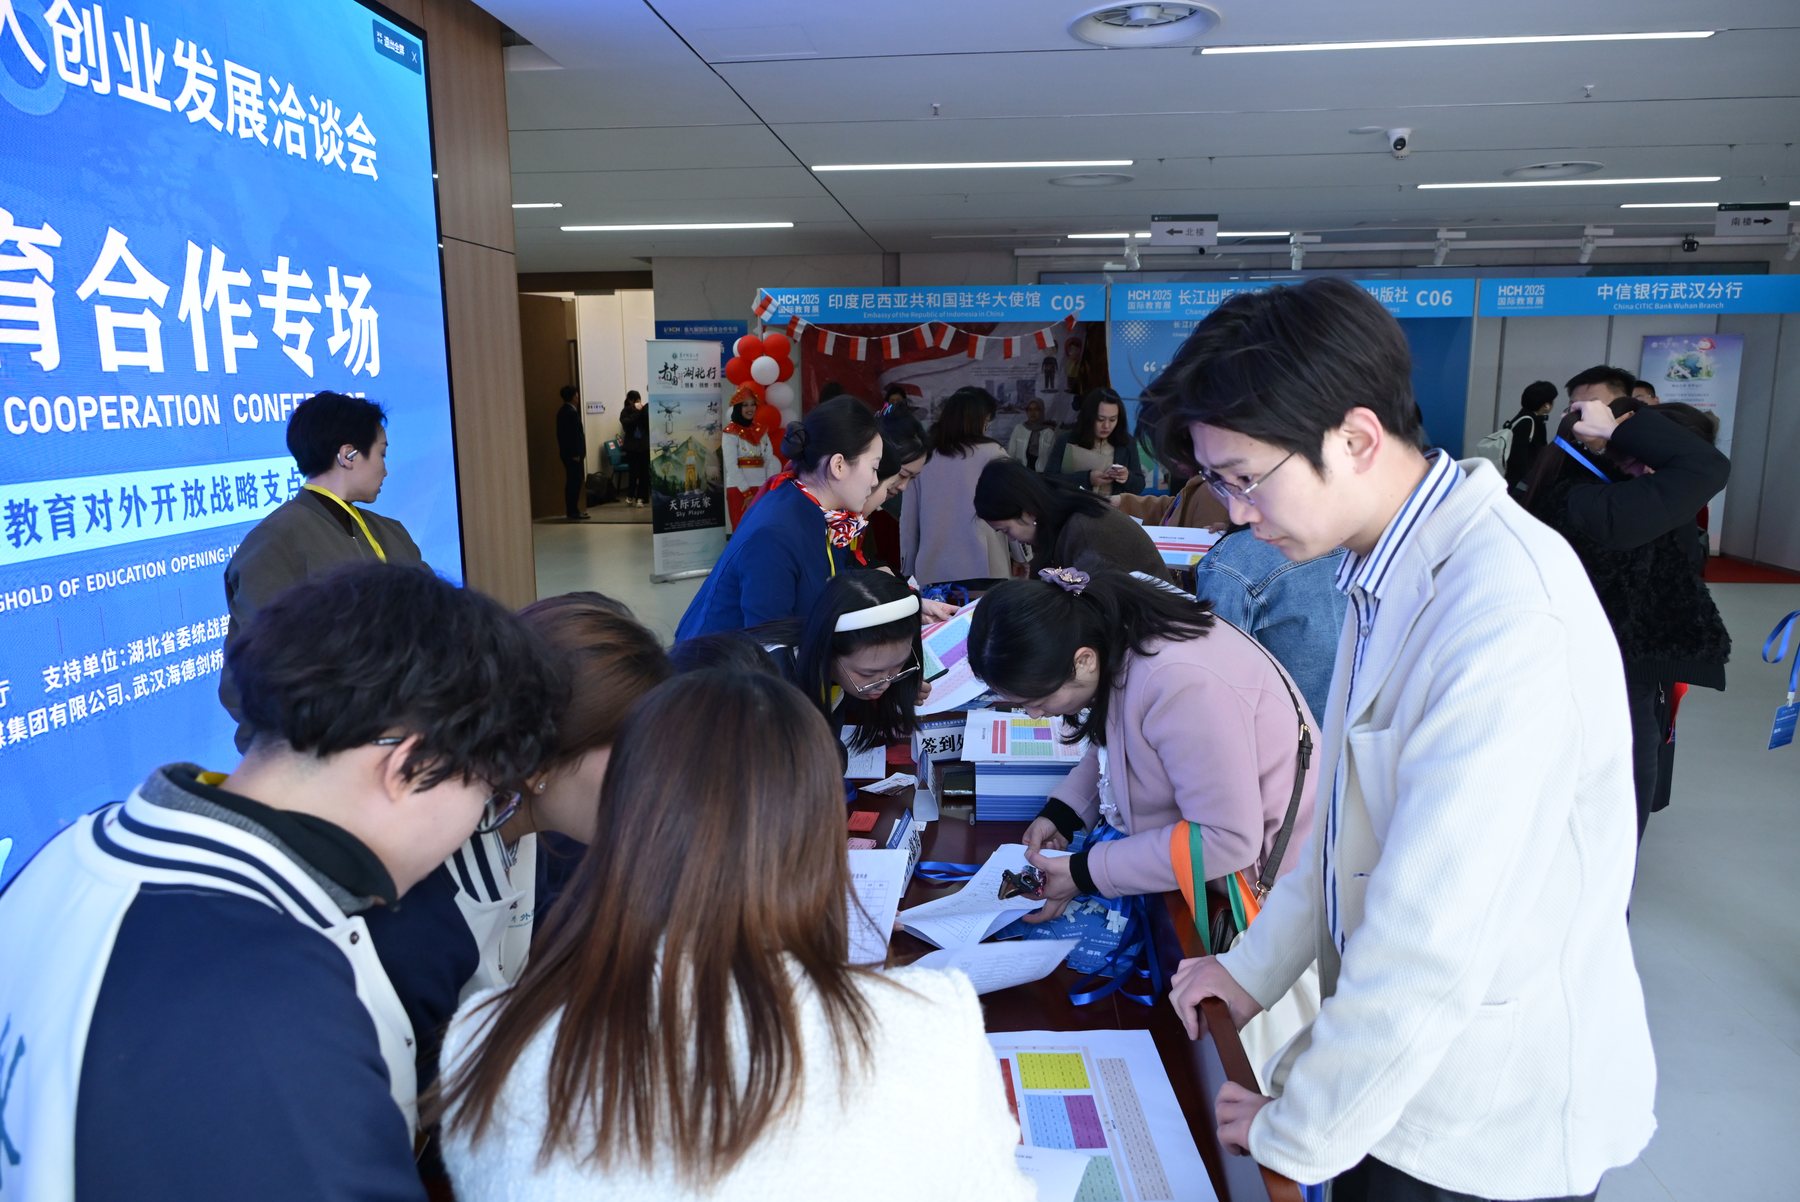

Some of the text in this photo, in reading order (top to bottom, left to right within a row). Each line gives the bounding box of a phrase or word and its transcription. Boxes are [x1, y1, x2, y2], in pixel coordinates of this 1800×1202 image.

[0, 206, 380, 378] 育合作专场
[1128, 290, 1172, 300] HCH 2025
[1416, 290, 1452, 306] C06
[1498, 285, 1544, 296] HCH 2025
[1597, 281, 1743, 300] 中信银行武汉分行
[778, 294, 819, 304] HCH 2025
[828, 291, 1041, 309] 印度尼西亚共和国驻华大使馆
[1051, 295, 1085, 310] C05
[1128, 301, 1171, 310] 国际教育展
[1497, 296, 1544, 306] 国际教育展
[3, 393, 221, 435] COOPERATION
[3, 467, 301, 549] 教育对外开放战略支点
[669, 496, 711, 511] 天际玩家
[59, 578, 80, 598] OF
[86, 560, 167, 592] EDUCATION
[171, 544, 240, 573] OPENING-U
